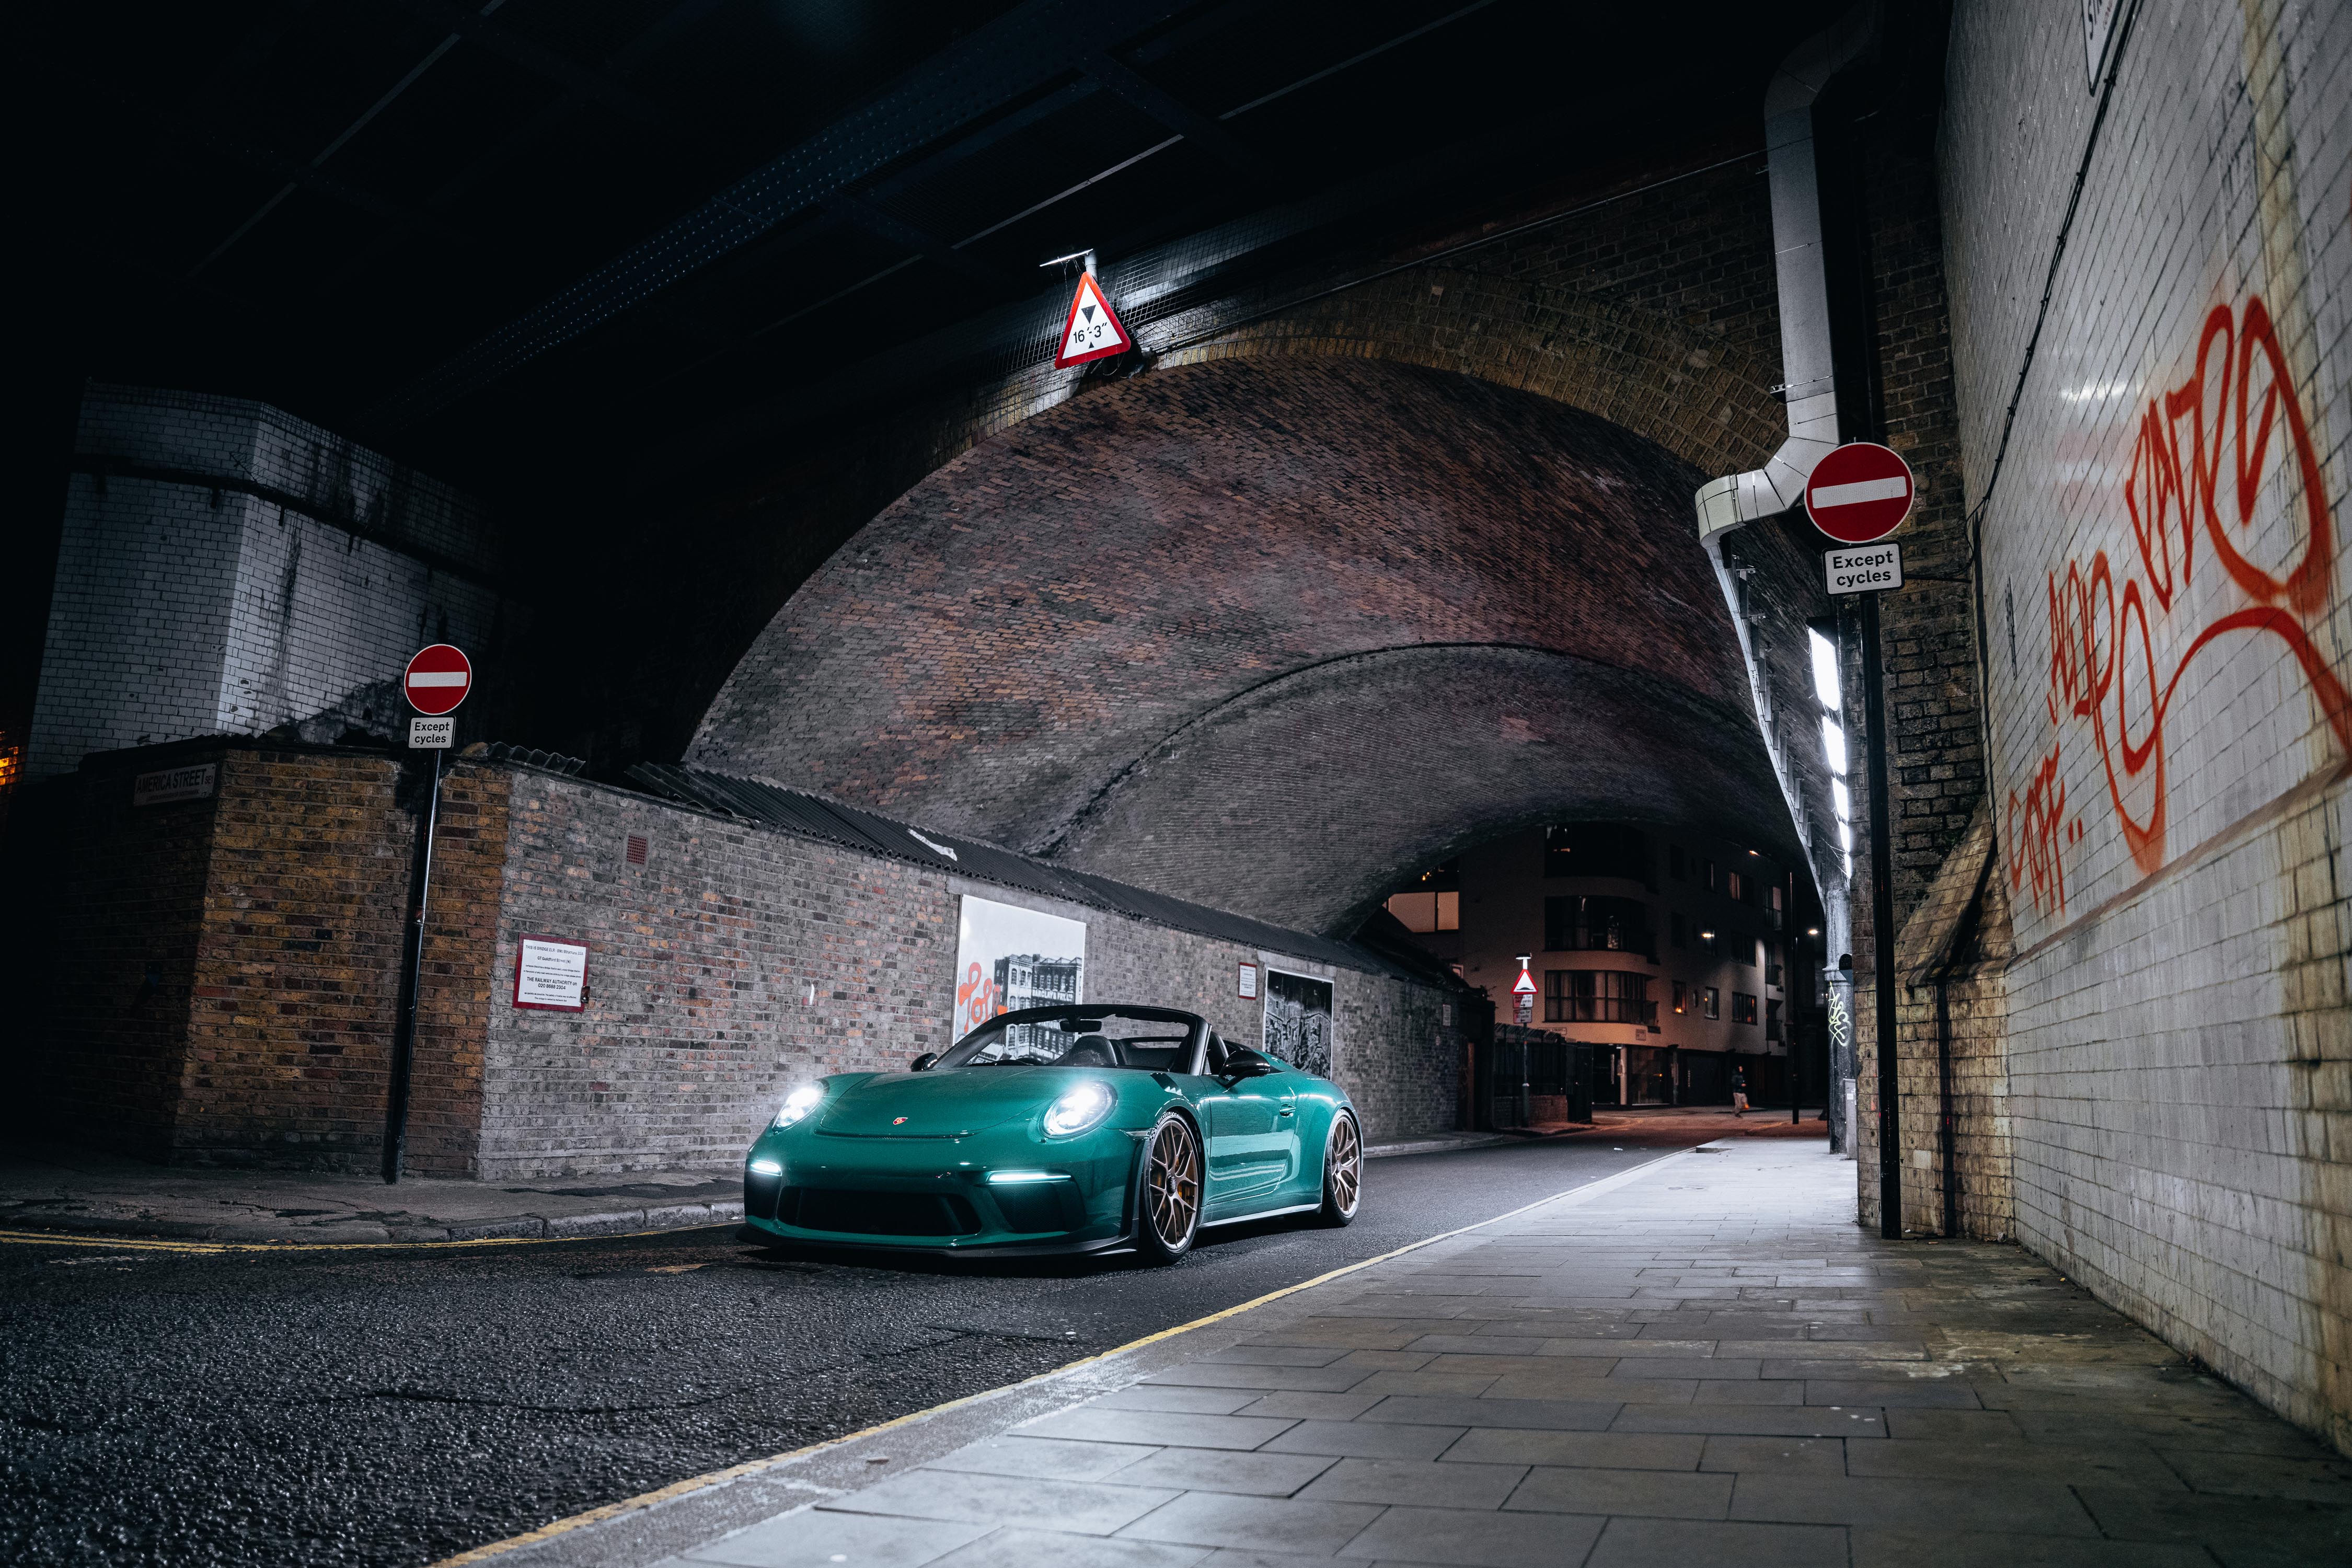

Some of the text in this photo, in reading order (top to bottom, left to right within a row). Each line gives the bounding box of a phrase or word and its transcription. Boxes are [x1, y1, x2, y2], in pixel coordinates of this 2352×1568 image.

[1832, 550, 1894, 569] Except
[1836, 570, 1892, 587] cycles
[414, 722, 450, 733] Except
[414, 734, 446, 745] cycles
[136, 774, 171, 794] AMERICA
[172, 768, 206, 788] STREET
